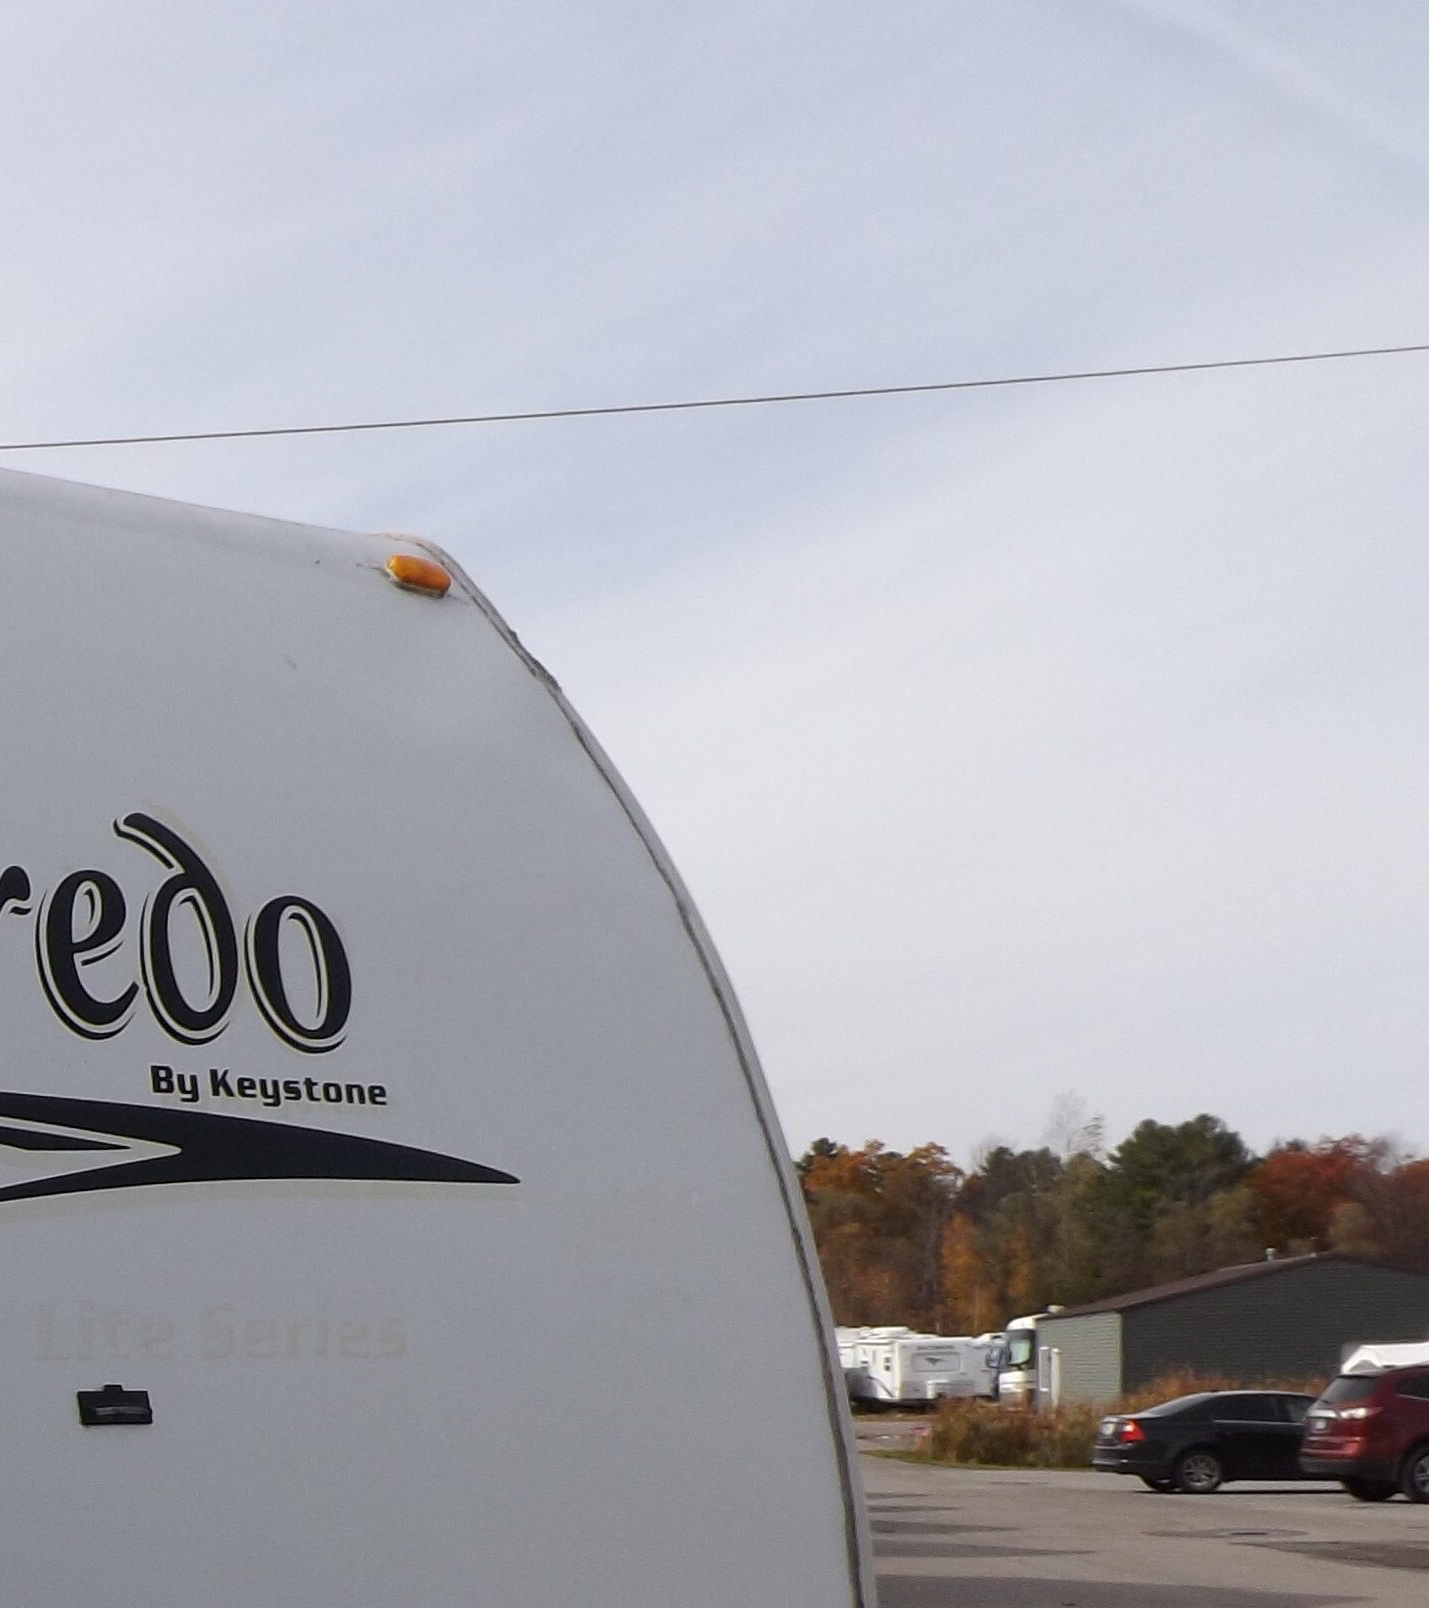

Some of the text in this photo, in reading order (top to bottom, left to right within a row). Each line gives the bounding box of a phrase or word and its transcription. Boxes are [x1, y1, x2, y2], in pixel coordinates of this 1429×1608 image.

[150, 1064, 388, 1107] By Keystone
[35, 1297, 179, 1362] Lite
[200, 1301, 410, 1363] Series
